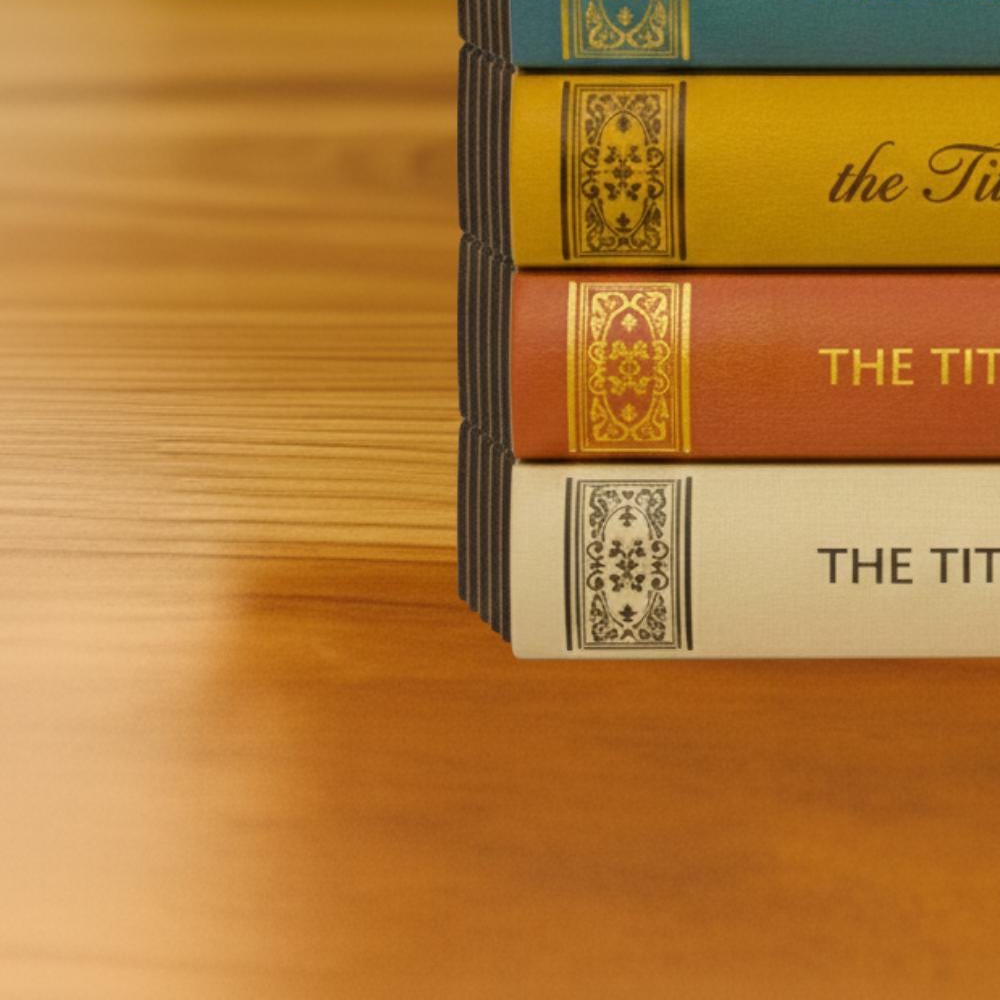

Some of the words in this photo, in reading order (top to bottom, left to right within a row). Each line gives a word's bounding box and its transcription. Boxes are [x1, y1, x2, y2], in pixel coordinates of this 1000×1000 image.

[828, 140, 908, 203] the
[818, 347, 914, 386] THE
[817, 546, 913, 584] THE
